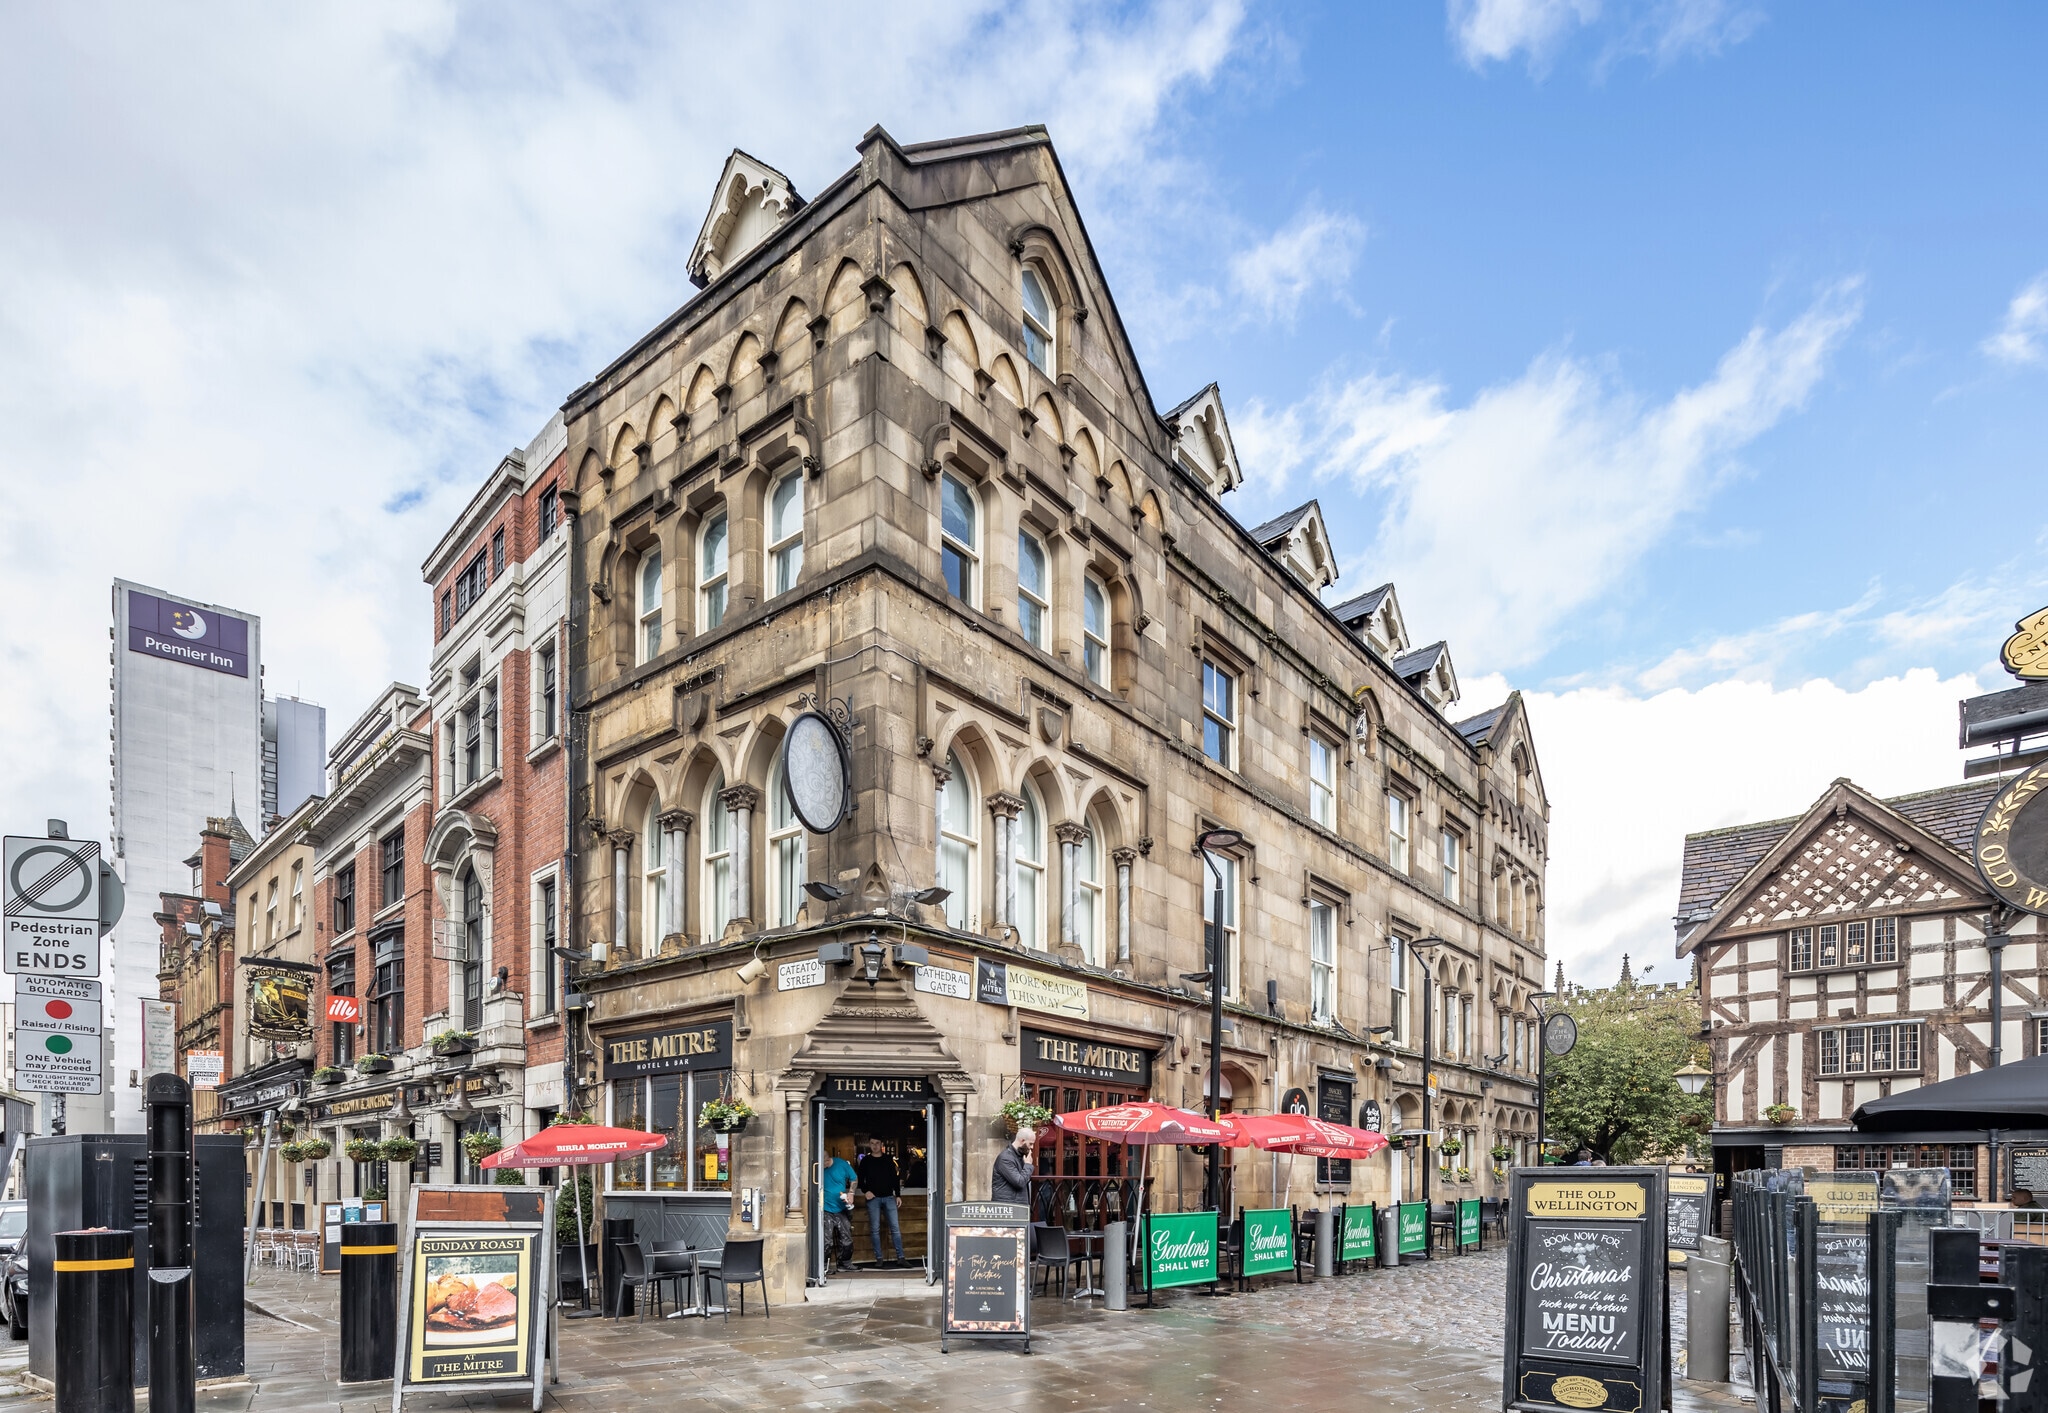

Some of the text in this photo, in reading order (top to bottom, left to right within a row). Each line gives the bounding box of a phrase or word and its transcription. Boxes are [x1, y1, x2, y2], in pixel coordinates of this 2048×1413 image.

[145, 636, 233, 668] Premier Inn
[1980, 844, 2018, 887] OLD
[11, 921, 92, 935] Pedestrian
[33, 936, 70, 947] Zone
[17, 952, 86, 970] ENDS
[255, 969, 286, 977] JOSEPH
[916, 967, 969, 985] CATHEDRAL
[26, 977, 92, 990] AUTOMATIC
[786, 974, 816, 987] STREET
[986, 978, 998, 986] THE
[1009, 972, 1084, 998] MORE SEATING
[30, 986, 88, 998] BOLLARDS
[930, 981, 957, 994] GATES
[981, 984, 1002, 995] MITRE
[1010, 990, 1061, 1009] THIS WAY
[328, 1000, 356, 1020] illy
[22, 1020, 56, 1029] Raised
[64, 1024, 96, 1033] Rising
[610, 1029, 717, 1064] THE MITRE
[26, 1054, 92, 1064] ONE Vehicle
[1037, 1037, 1140, 1072] THE MITRE
[637, 1061, 661, 1070] HOTEL
[1062, 1065, 1086, 1074] HOTEL
[466, 1079, 482, 1092] HOLT
[834, 1079, 922, 1092] THE MITRE
[587, 1142, 627, 1150] MORETTI
[1557, 1190, 1616, 1199] THE OLD
[1535, 1200, 1638, 1212] WELLINGTON
[1344, 1218, 1370, 1240] Gordon's
[1402, 1214, 1423, 1235] Gordon's
[1250, 1224, 1287, 1251] Gordon's
[1543, 1232, 1620, 1249] BOOK NOW FOR
[423, 1238, 523, 1252] SUNDAY ROAST
[1152, 1230, 1210, 1261] Gordon's
[1276, 1250, 1288, 1258] WE?
[957, 1256, 965, 1267] A
[990, 1254, 1017, 1270] Special
[1191, 1258, 1210, 1268] WE?
[1530, 1262, 1632, 1291] Christmas
[1603, 1292, 1615, 1302] in
[1564, 1302, 1578, 1310] up
[1589, 1302, 1628, 1313] festive
[1543, 1312, 1615, 1334] MENU
[1546, 1328, 1627, 1353] Today!
[434, 1360, 504, 1373] THE MITRE
